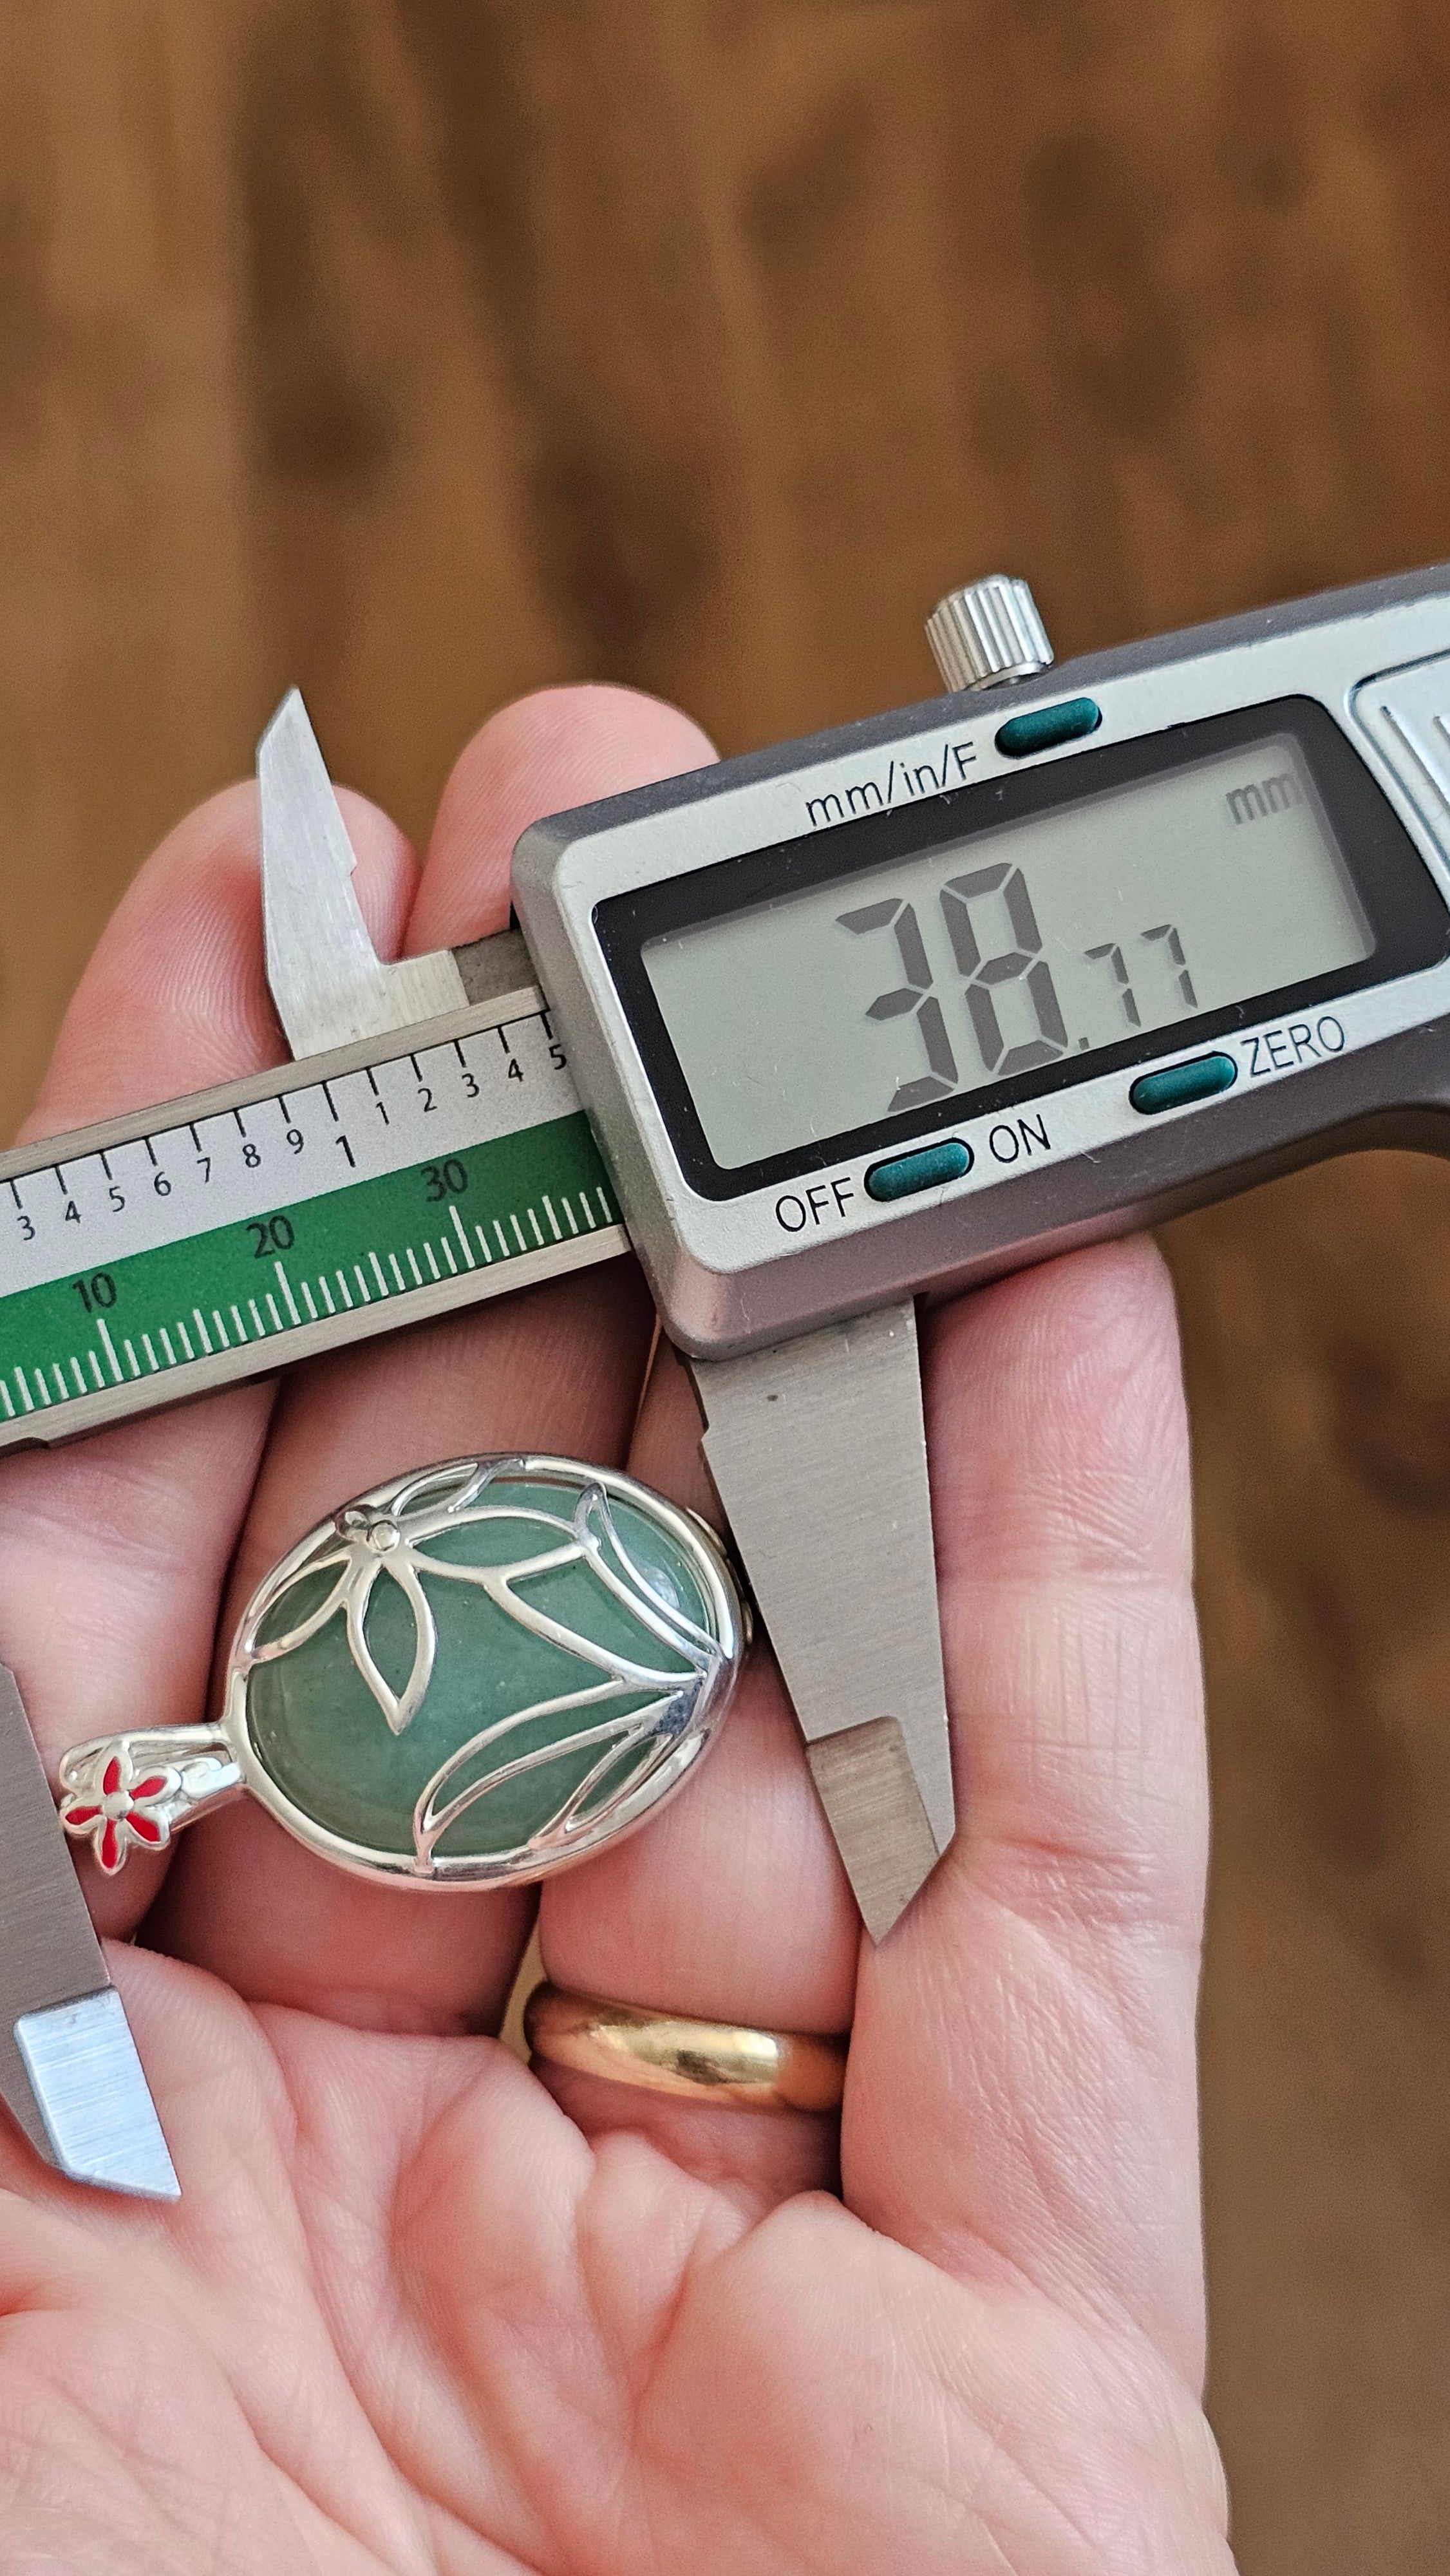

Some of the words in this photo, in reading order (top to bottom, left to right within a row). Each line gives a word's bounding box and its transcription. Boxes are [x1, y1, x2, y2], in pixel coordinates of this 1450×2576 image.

[805, 741, 977, 826] mm/in/F
[1225, 772, 1301, 826] mm
[835, 862, 1198, 1113] 38.77
[1240, 1015, 1346, 1079] ZERO
[17, 1216, 35, 1242] 3
[64, 1201, 82, 1225] 4
[109, 1188, 126, 1213] 5
[154, 1172, 171, 1197] 6
[196, 1157, 212, 1183] 7
[243, 1144, 261, 1168] 8
[286, 1130, 305, 1155] 9
[335, 1136, 356, 1167] 1
[376, 1103, 390, 1124] 1
[417, 1088, 437, 1112] 2
[462, 1074, 480, 1099] 3
[506, 1059, 524, 1083] 4
[549, 1045, 567, 1071] 5
[988, 1113, 1052, 1164] ON
[72, 1273, 117, 1313] 10
[245, 1215, 295, 1259] 20
[421, 1160, 468, 1202] 30
[775, 1177, 855, 1233] OFF
